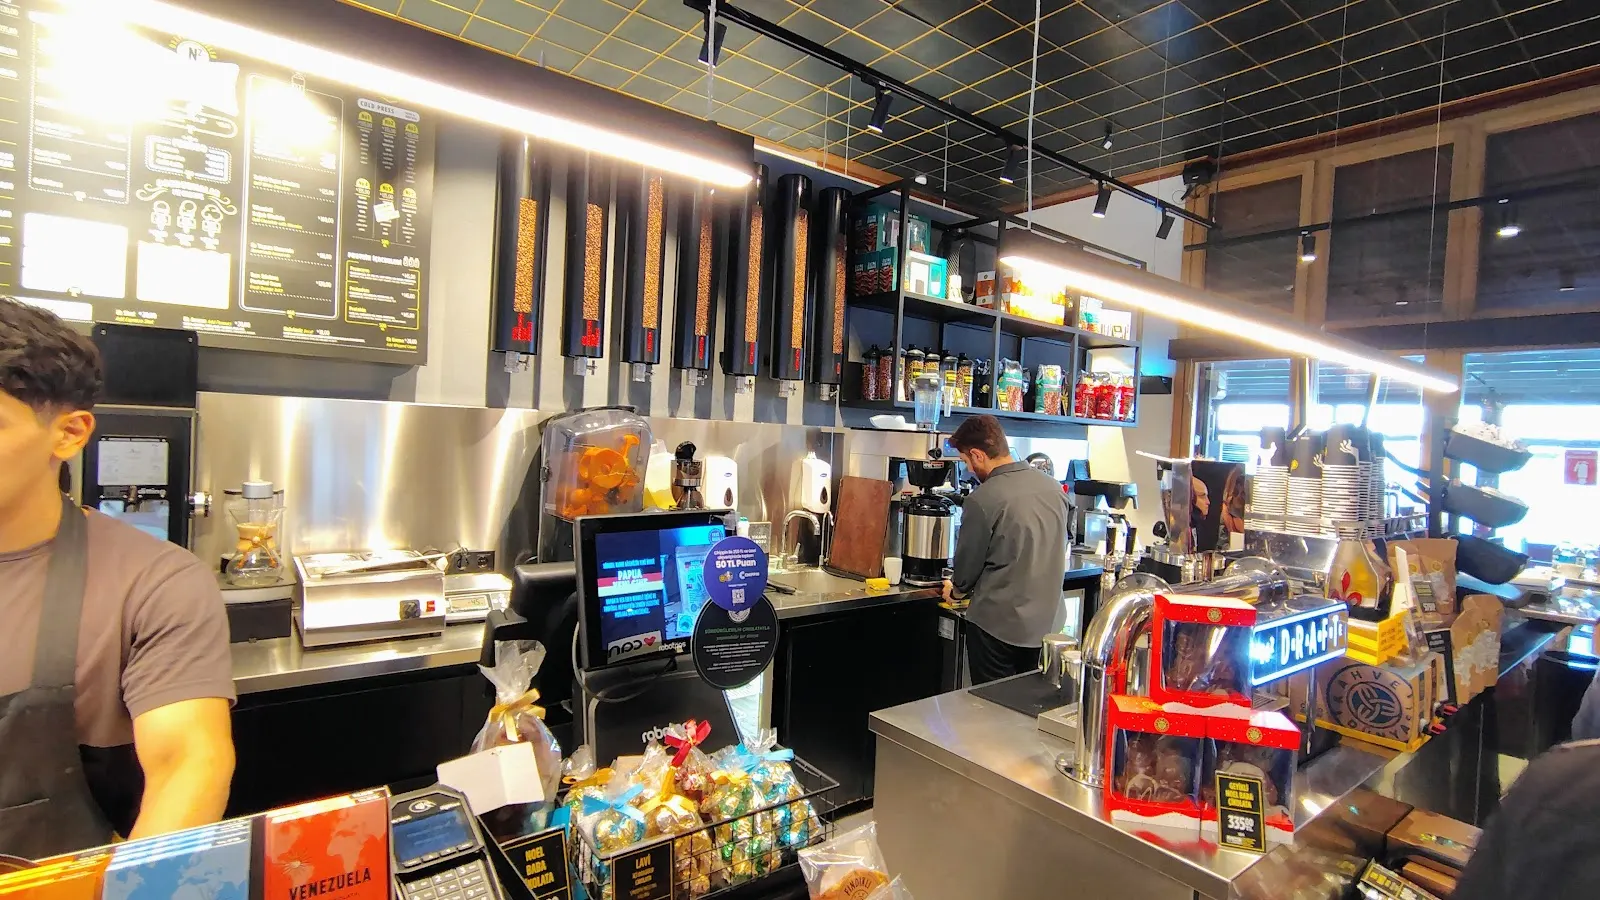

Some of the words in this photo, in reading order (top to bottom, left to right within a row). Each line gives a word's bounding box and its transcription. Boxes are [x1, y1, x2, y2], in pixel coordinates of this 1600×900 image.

[377, 105, 395, 114] PRESS
[716, 560, 726, 568] 50
[726, 560, 736, 568] TL
[736, 559, 756, 567] Puan
[525, 846, 545, 862] NOEL
[636, 854, 651, 870] LAVİ
[526, 860, 547, 876] BABA
[289, 868, 372, 900] VENEZUELA
